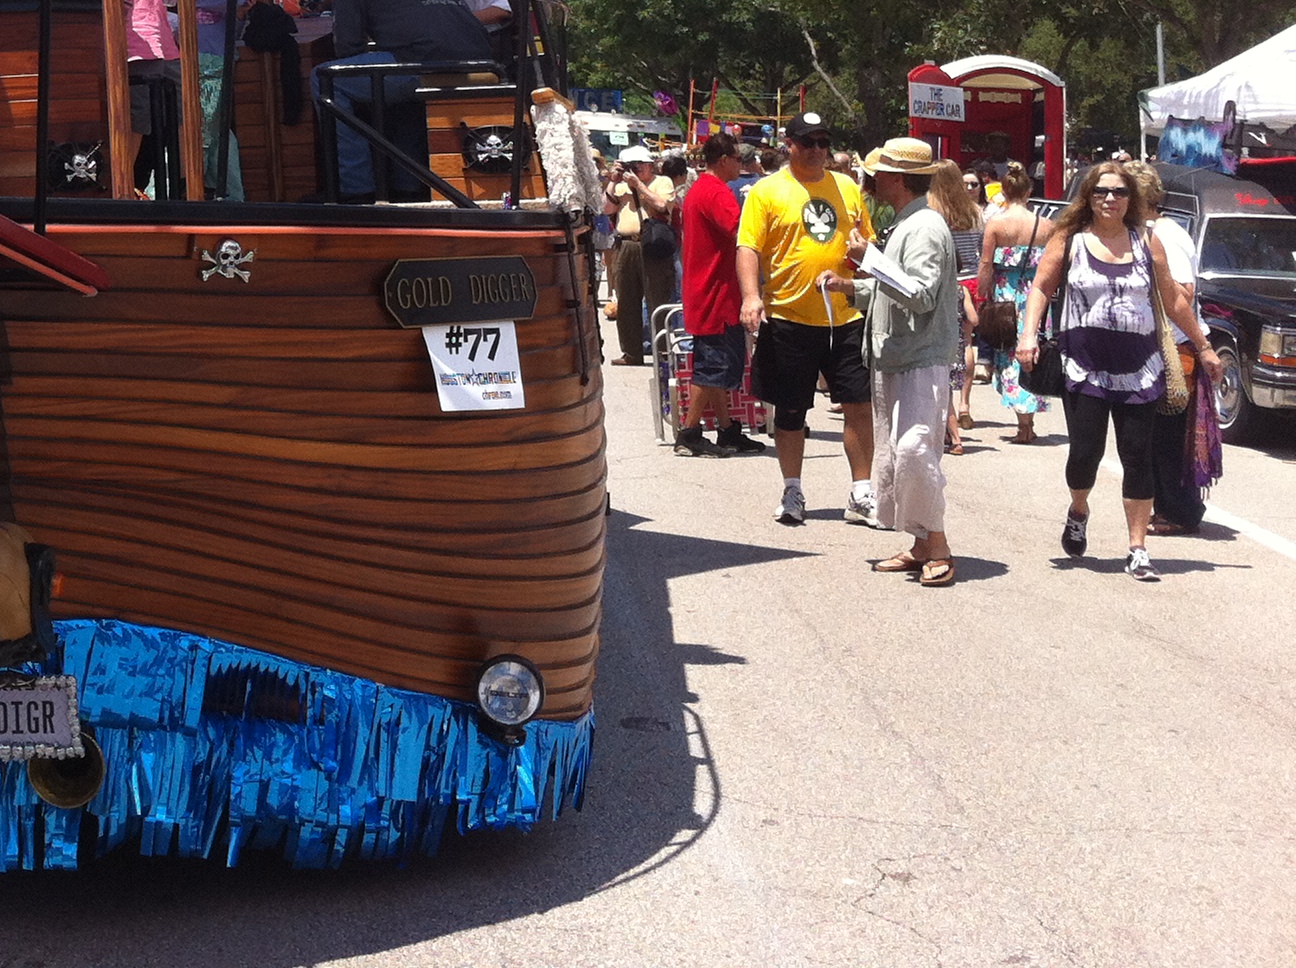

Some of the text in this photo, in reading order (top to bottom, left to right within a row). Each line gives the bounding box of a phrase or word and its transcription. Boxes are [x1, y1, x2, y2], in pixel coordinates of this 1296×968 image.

[929, 87, 943, 101] THE
[913, 99, 961, 118] CRAPPER CAR
[397, 273, 530, 310] GOLD DIGGER
[445, 325, 501, 363] #77
